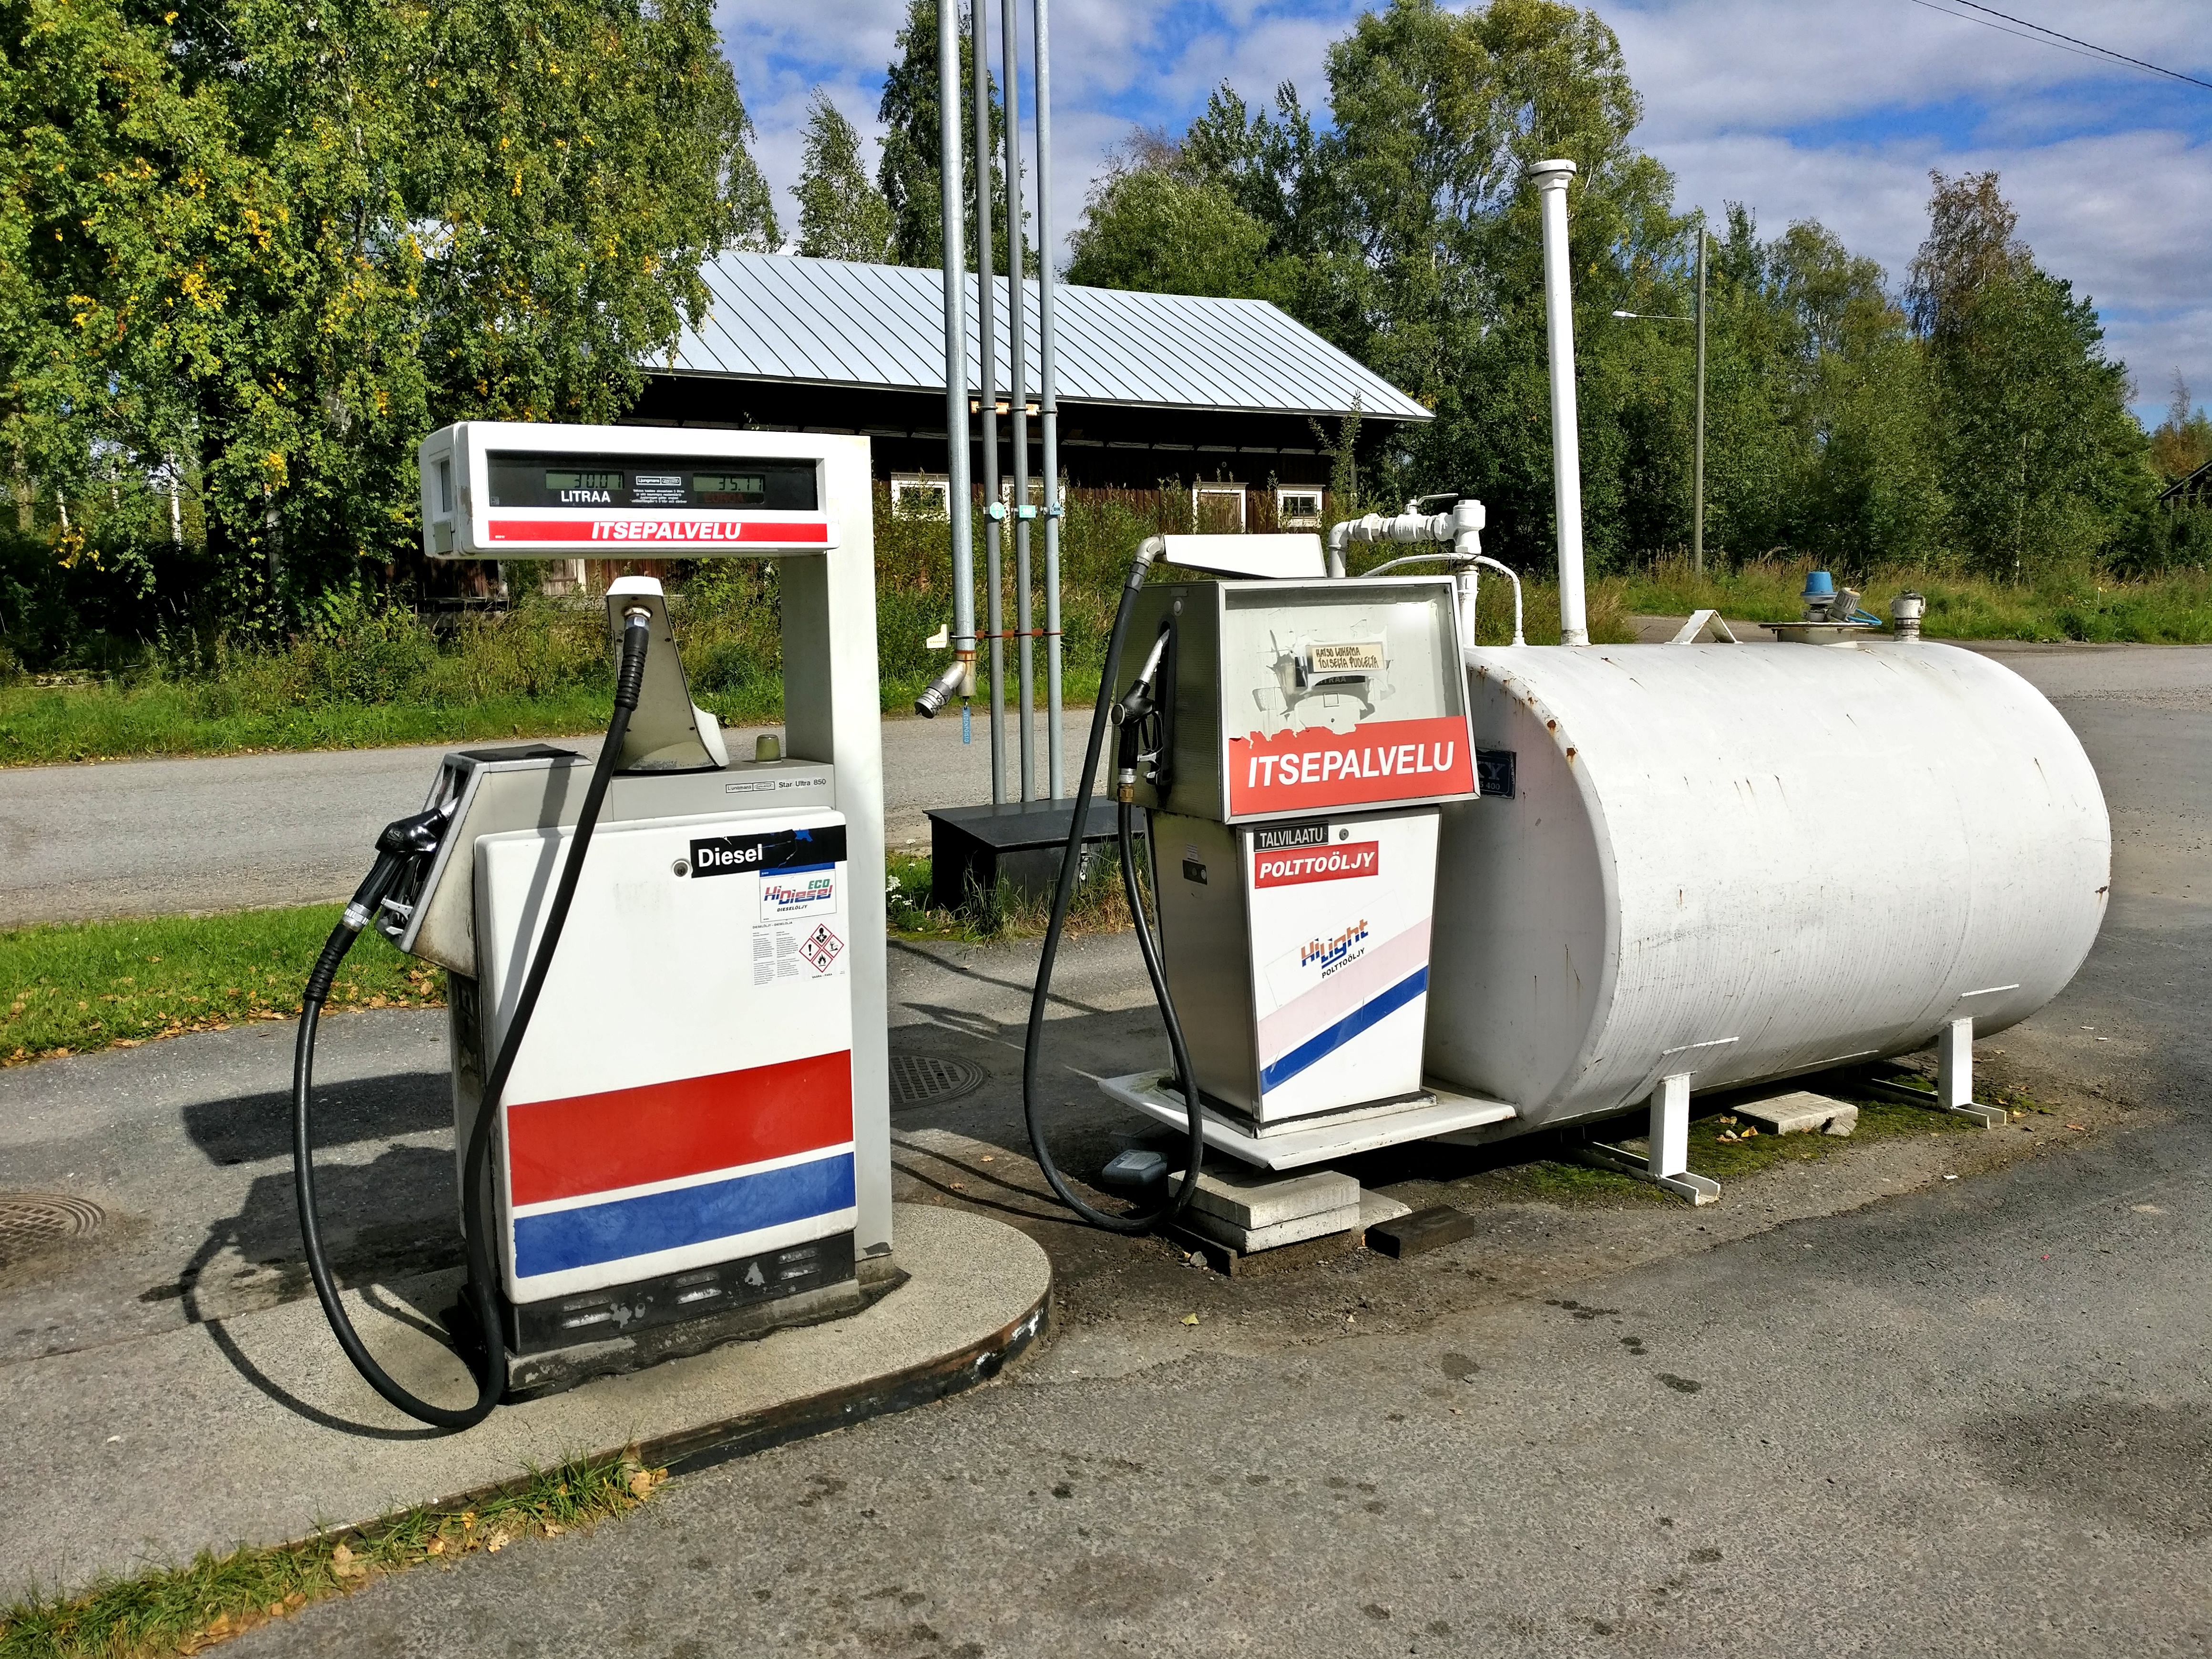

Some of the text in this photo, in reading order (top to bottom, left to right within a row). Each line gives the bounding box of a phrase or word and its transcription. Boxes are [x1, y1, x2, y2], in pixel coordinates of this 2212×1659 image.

[561, 491, 611, 502] LITRAA
[592, 522, 741, 539] ITSEPALVELU
[1316, 647, 1361, 657] KATSO LUKEMA
[1318, 655, 1379, 668] TOISELTA PUOLELTA
[1248, 741, 1454, 788] ITSEPALVELU
[1260, 827, 1323, 847] TALVILAATU
[698, 843, 763, 867] Diesel
[1260, 851, 1375, 879] POLTTOÖLJY
[808, 879, 830, 890] ECO
[1322, 947, 1365, 978] POLTTOÖLJY
